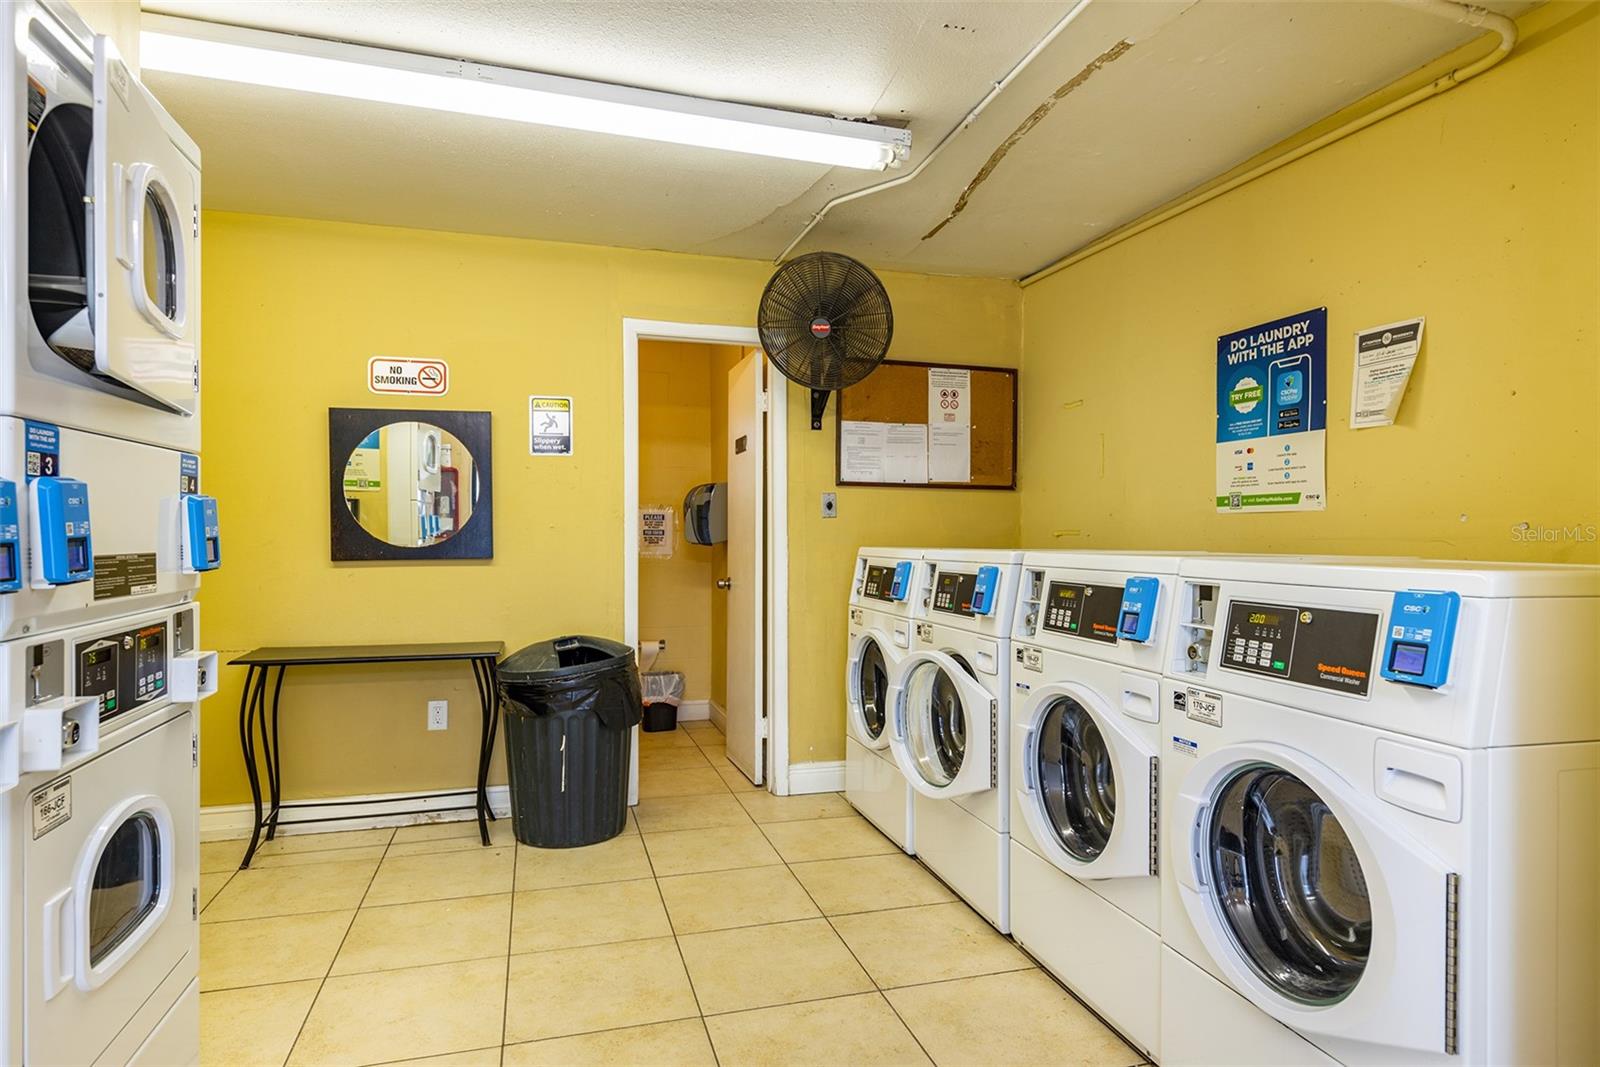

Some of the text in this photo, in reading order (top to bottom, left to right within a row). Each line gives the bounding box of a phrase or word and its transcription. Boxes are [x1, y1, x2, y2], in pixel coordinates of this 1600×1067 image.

[1230, 320, 1310, 352] DO LAUNDRY
[1227, 333, 1314, 365] WITH THE APP
[389, 366, 402, 374] NO
[374, 375, 417, 385] SMOKING
[1231, 389, 1261, 401] TRY FREE
[541, 401, 568, 409] CAUTION
[534, 437, 560, 446] Slippery
[45, 457, 53, 474] 3
[190, 479, 195, 491] 4
[1317, 663, 1366, 678] Speed Queen
[1320, 672, 1360, 685] Commercial Washer
[1193, 701, 1215, 712] 170-JCF
